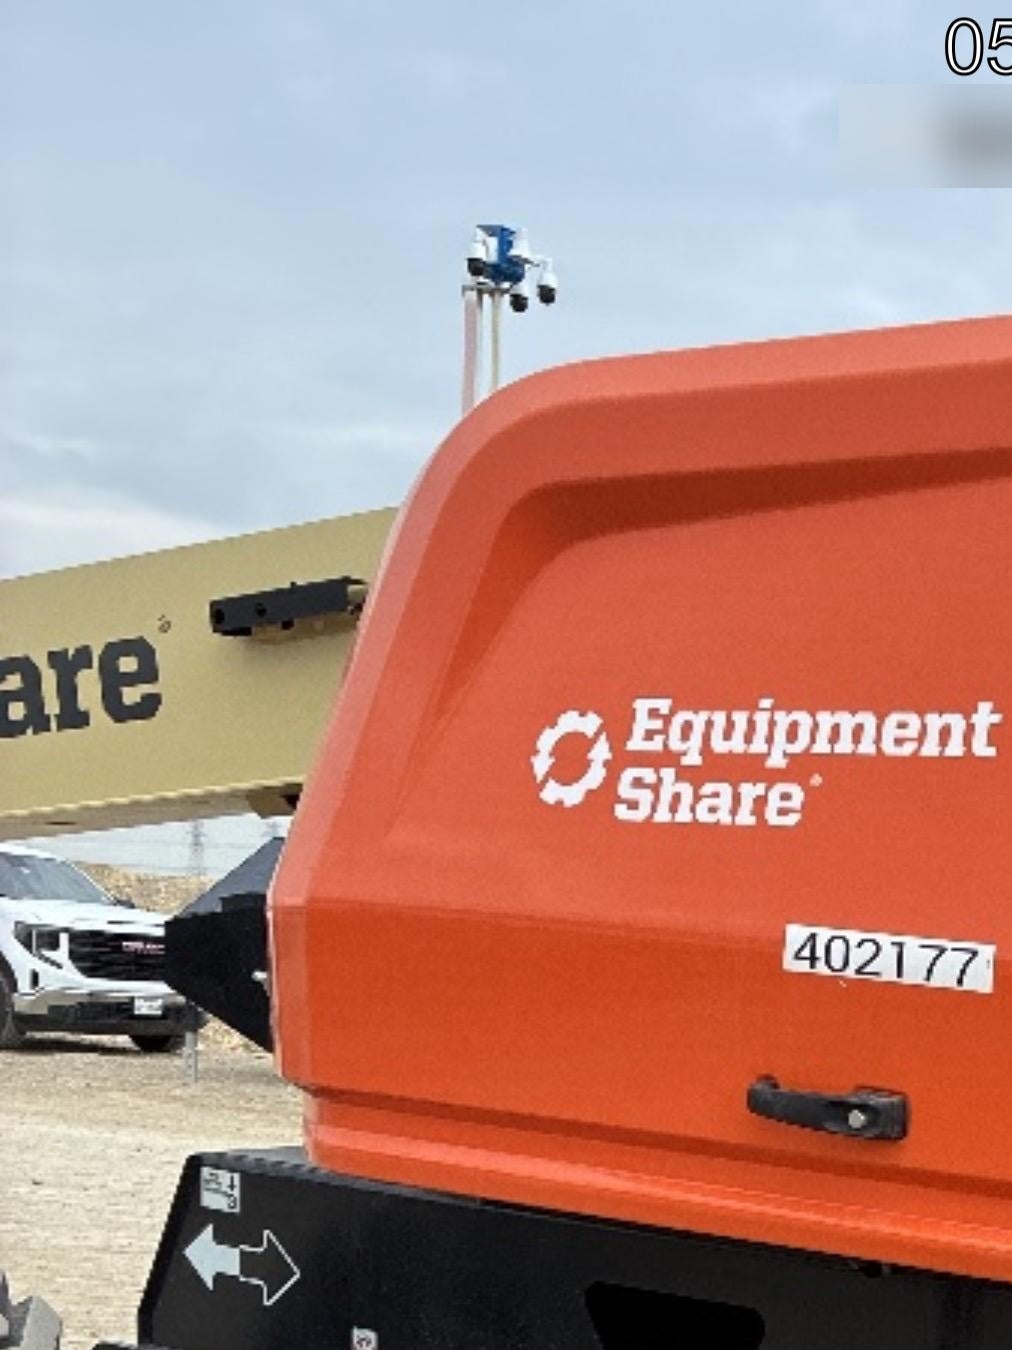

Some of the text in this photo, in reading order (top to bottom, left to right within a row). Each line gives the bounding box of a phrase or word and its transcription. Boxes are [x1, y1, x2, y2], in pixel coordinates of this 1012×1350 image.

[626, 698, 1002, 768] Equipment
[613, 767, 804, 826] Share
[794, 932, 980, 987] 402177
